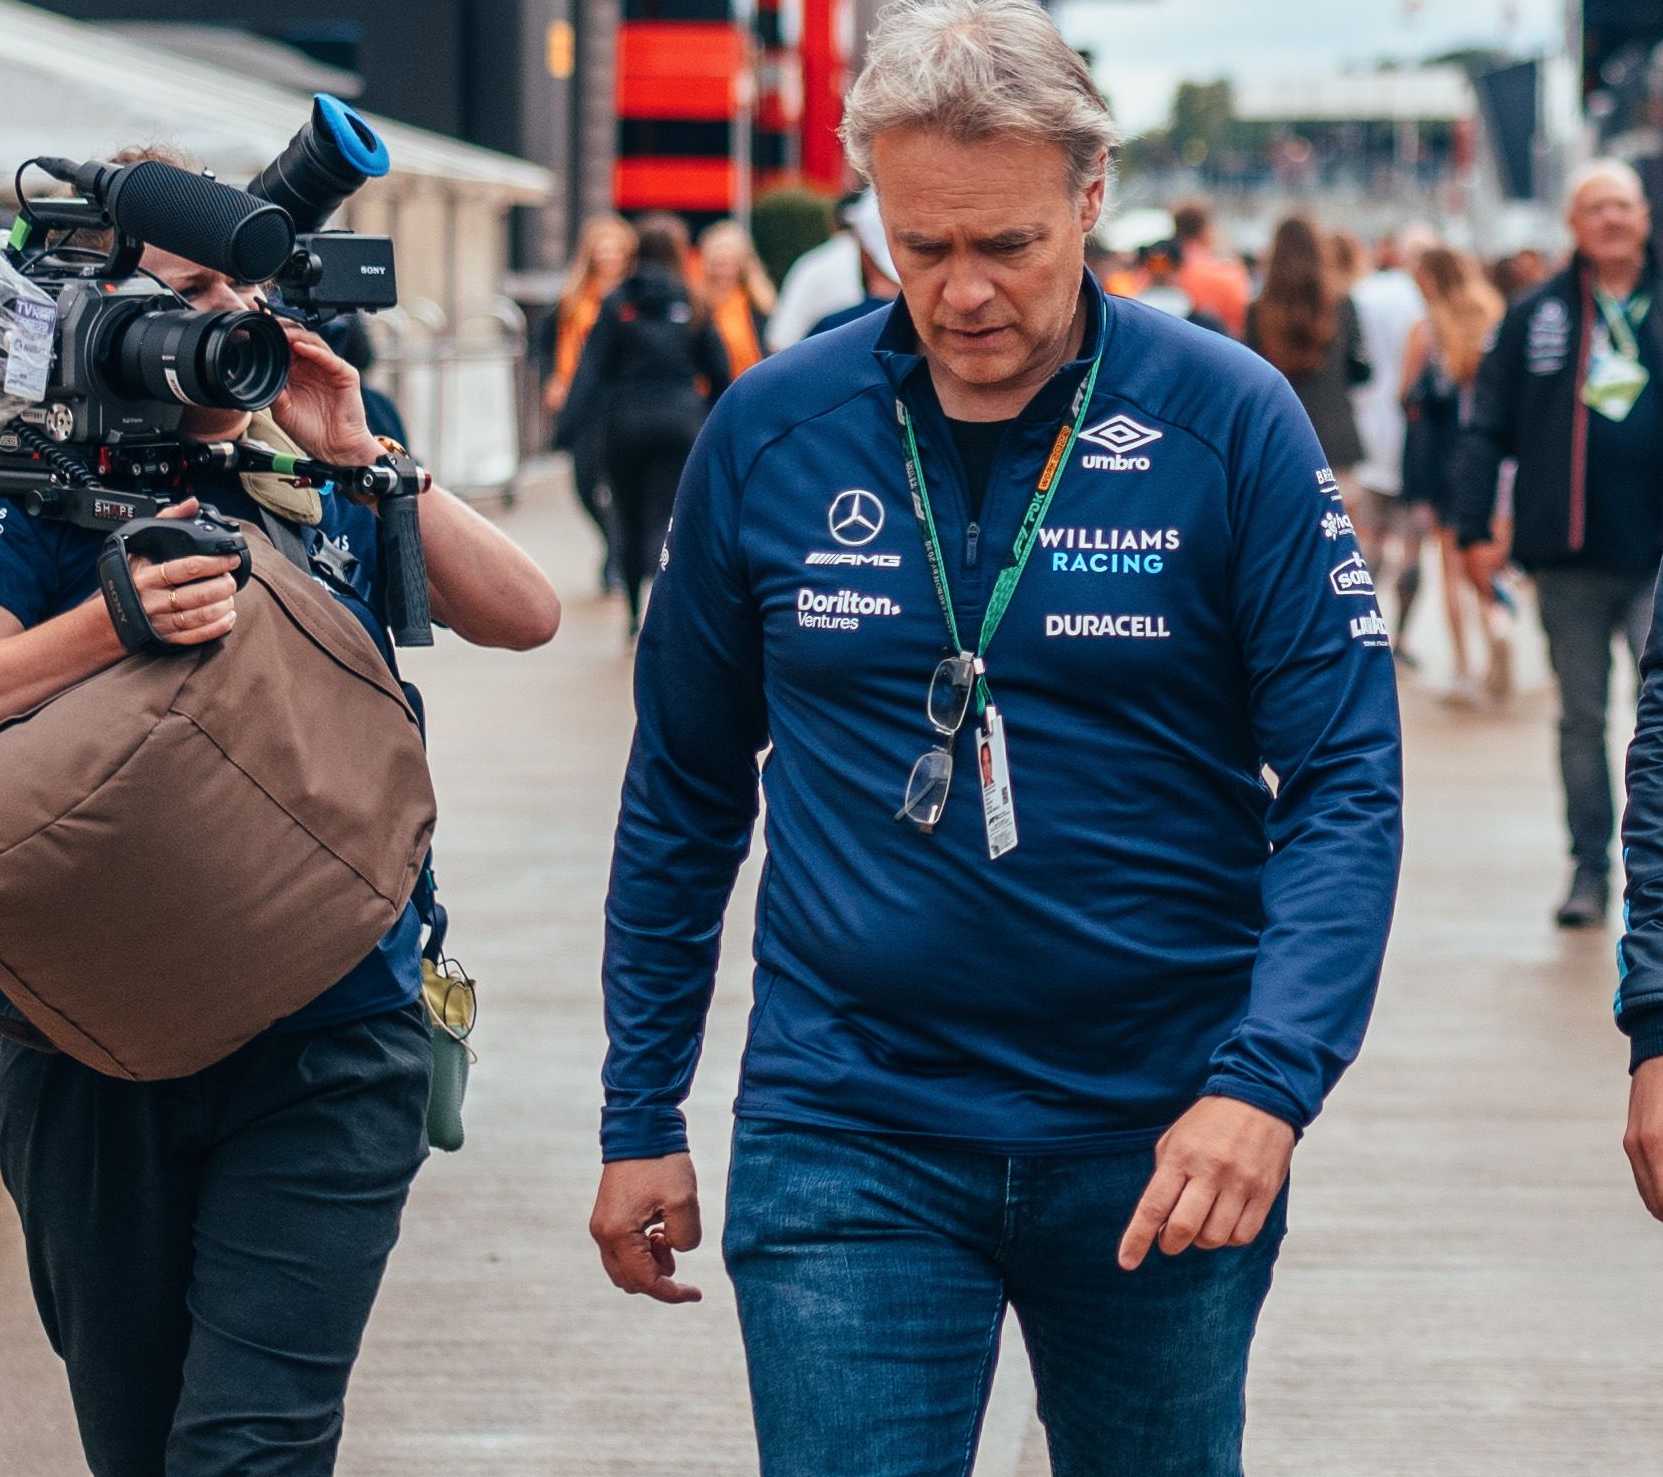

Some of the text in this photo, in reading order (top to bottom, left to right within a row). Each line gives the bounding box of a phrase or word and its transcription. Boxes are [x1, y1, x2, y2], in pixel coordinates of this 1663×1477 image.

[360, 265, 386, 275] SONY
[1082, 455, 1151, 471] umbro
[1038, 528, 1181, 550] WILLIAMS
[834, 554, 901, 568] AMG
[1052, 552, 1163, 573] RACING
[798, 612, 859, 630] Ventures
[1046, 615, 1170, 638] DURACELL
